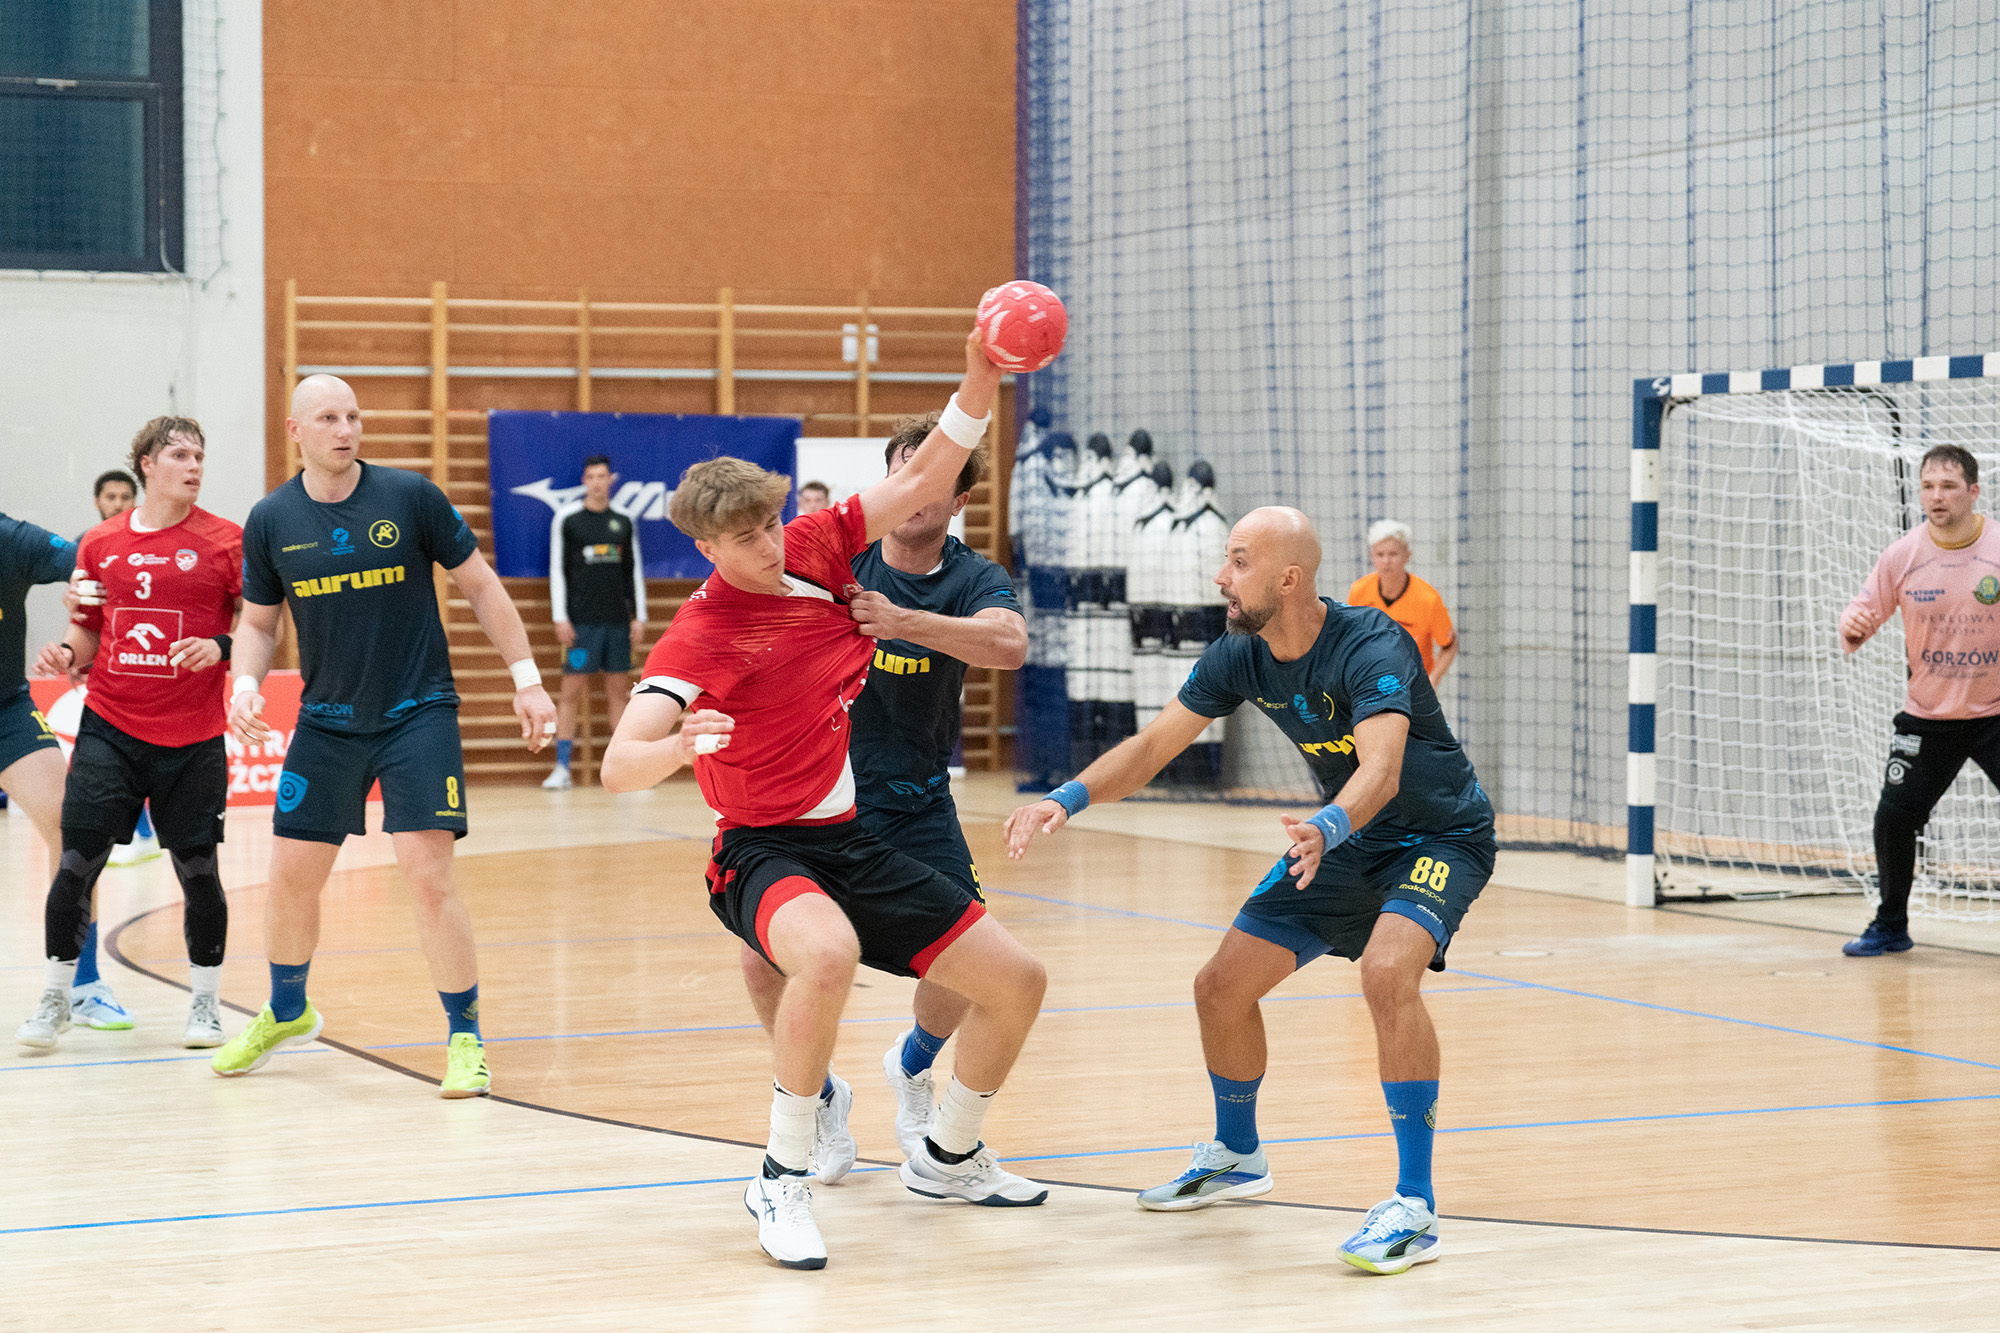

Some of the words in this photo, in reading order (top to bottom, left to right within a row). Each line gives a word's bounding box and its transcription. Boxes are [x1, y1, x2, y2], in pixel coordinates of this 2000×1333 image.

[135, 571, 152, 600] 3
[292, 565, 405, 598] aurum
[118, 652, 168, 667] ORLEN
[873, 648, 930, 675] um
[1921, 648, 1999, 667] GORZÓW
[228, 758, 284, 798] ŻCZ
[446, 775, 460, 809] 8
[1410, 856, 1450, 892] 88
[1398, 883, 1446, 906] makesport
